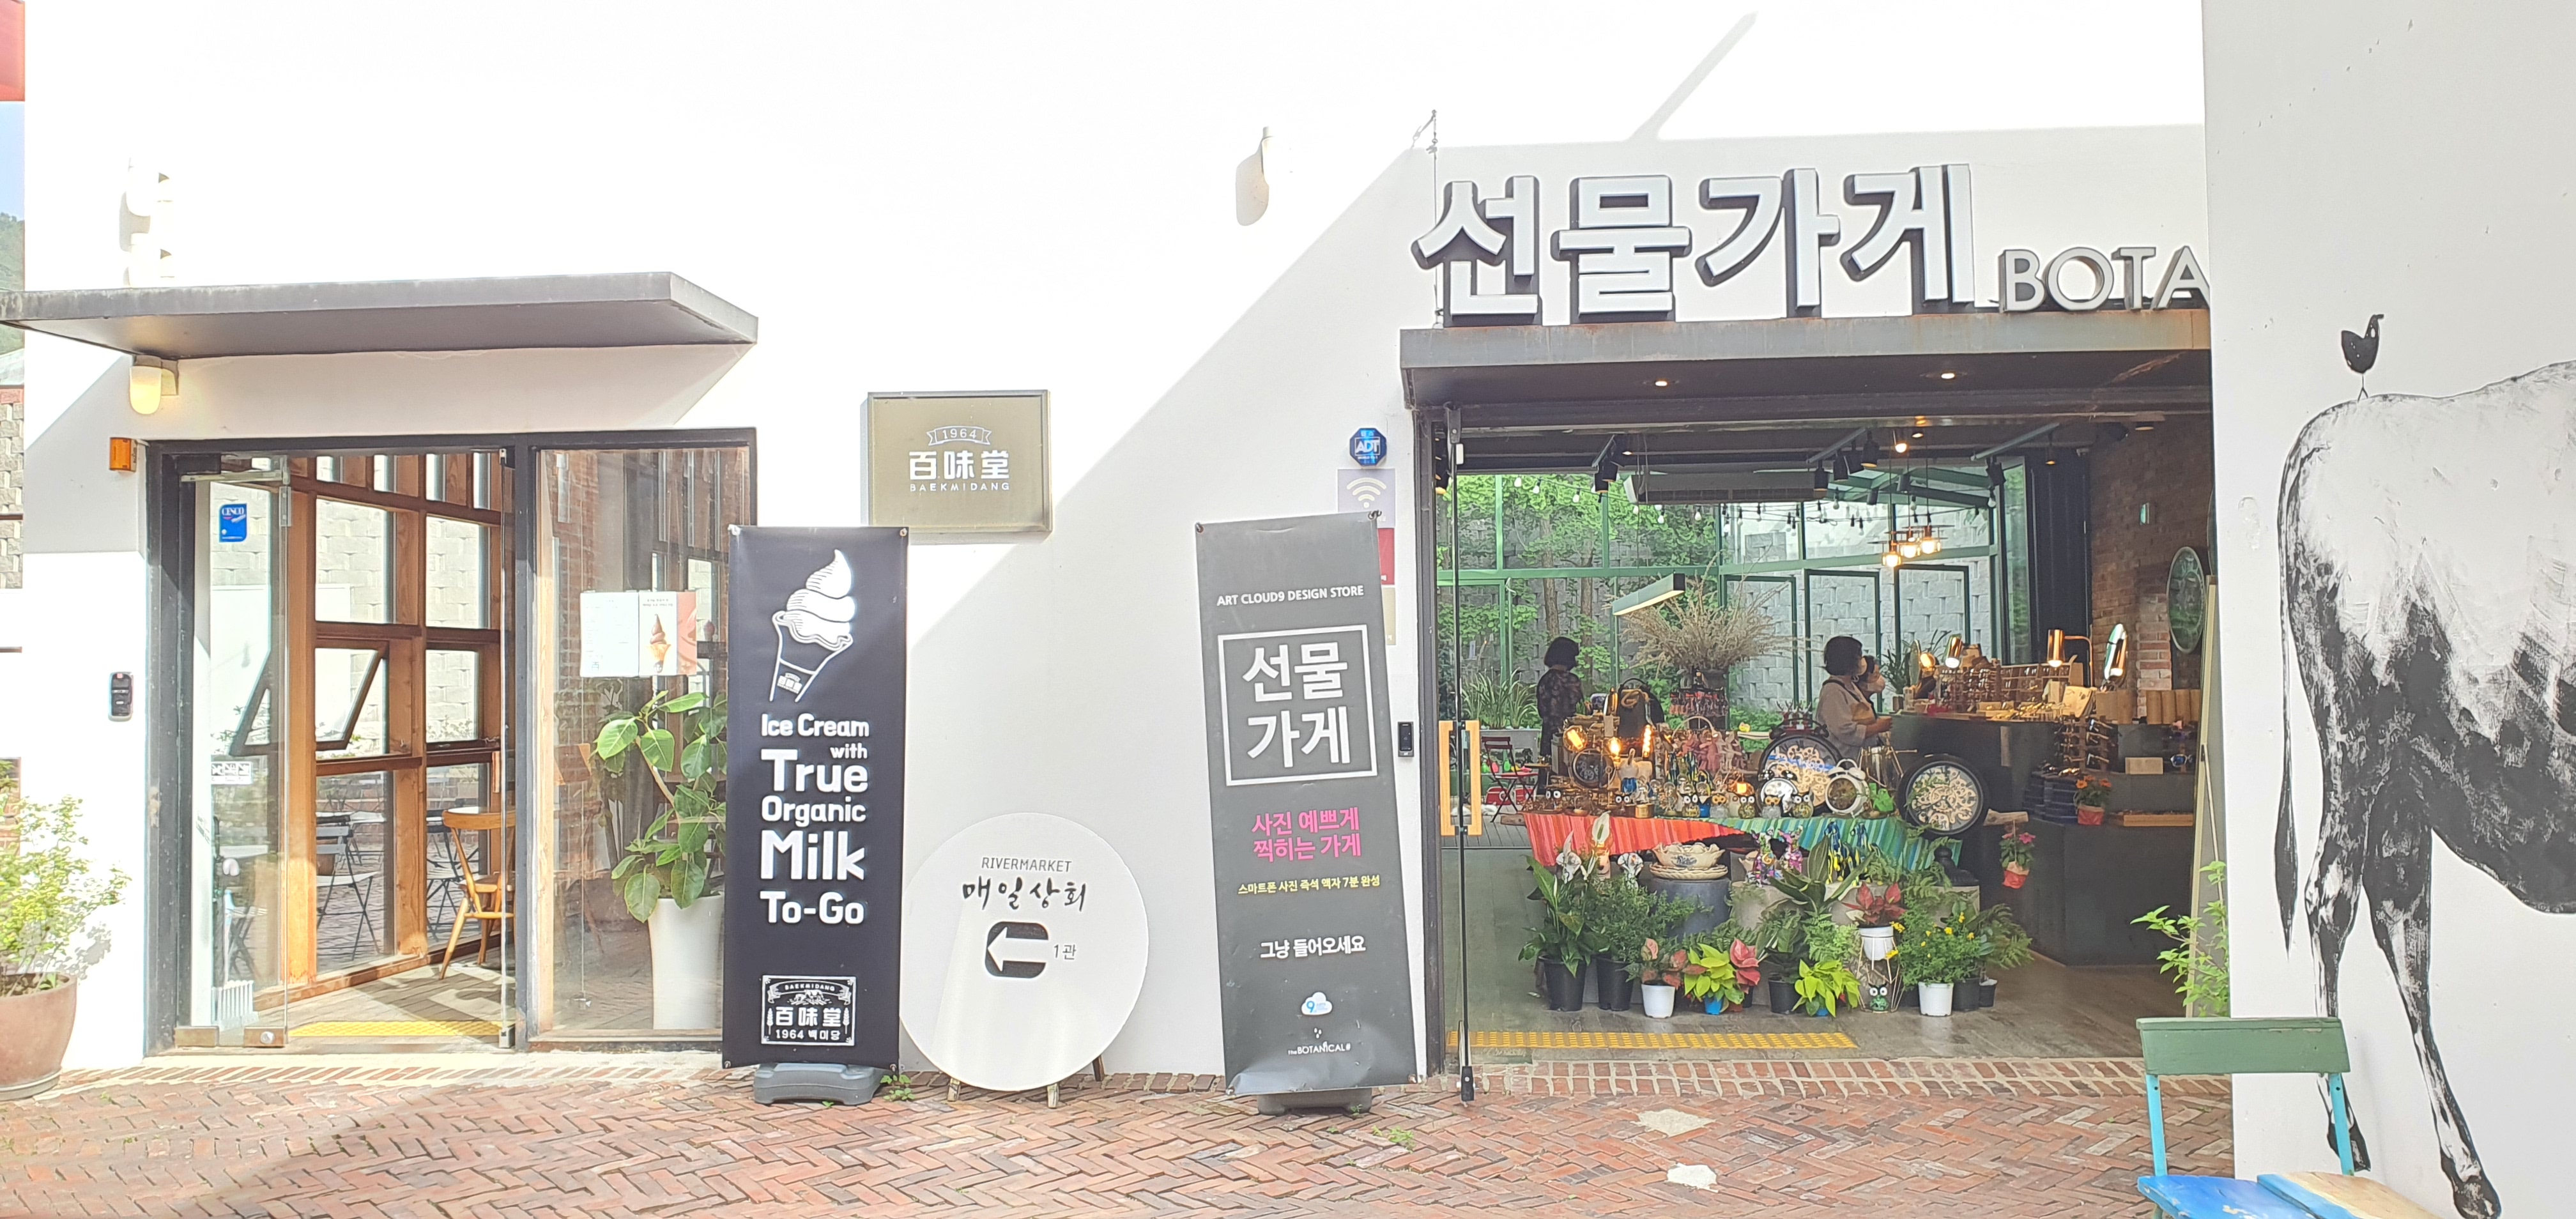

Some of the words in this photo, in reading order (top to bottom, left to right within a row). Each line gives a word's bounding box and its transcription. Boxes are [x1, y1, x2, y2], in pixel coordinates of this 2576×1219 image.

[1413, 164, 1974, 325] 선물가게
[1999, 245, 2211, 312] BOTA
[942, 428, 977, 440] 1964
[1355, 439, 1380, 453] ADT
[908, 450, 1009, 480] 百味堂
[910, 482, 1009, 492] BAEKMIDANG
[1216, 594, 1238, 606] ART
[1241, 590, 1285, 605] CLOUD9
[1287, 587, 1328, 602] DESIGN
[1330, 585, 1364, 598] STORE
[1242, 641, 1348, 702] 선물
[761, 713, 793, 737] Ice
[797, 712, 870, 737] Cream
[1246, 705, 1351, 768] 가게
[830, 742, 868, 759] with
[760, 748, 869, 792] True
[761, 795, 866, 827] Organic
[1251, 811, 1292, 838] 사진
[1298, 807, 1360, 833] 예쁘게
[760, 829, 865, 880] Milk
[1252, 836, 1316, 863] 찍히는
[1320, 832, 1361, 859] 가게
[981, 857, 1072, 873] RIVERMARKET
[963, 875, 1087, 912] 매일상회
[1238, 881, 1277, 895] 스마트폰
[1278, 880, 1298, 893] 사진
[1300, 878, 1320, 891] 즉석
[1321, 877, 1341, 889] 액자
[1342, 875, 1360, 888] 7분
[1360, 874, 1381, 887] 완성
[759, 891, 864, 924] To-Go
[1053, 943, 1077, 961] 1관
[1260, 939, 1291, 960] 그냥
[1292, 935, 1366, 958] 들어오세요
[785, 983, 836, 992] BAEKMIDANG
[776, 1006, 841, 1027] 百味堂
[1306, 1000, 1315, 1013] 9
[775, 1029, 805, 1039] 1964
[808, 1029, 841, 1041] 백미당
